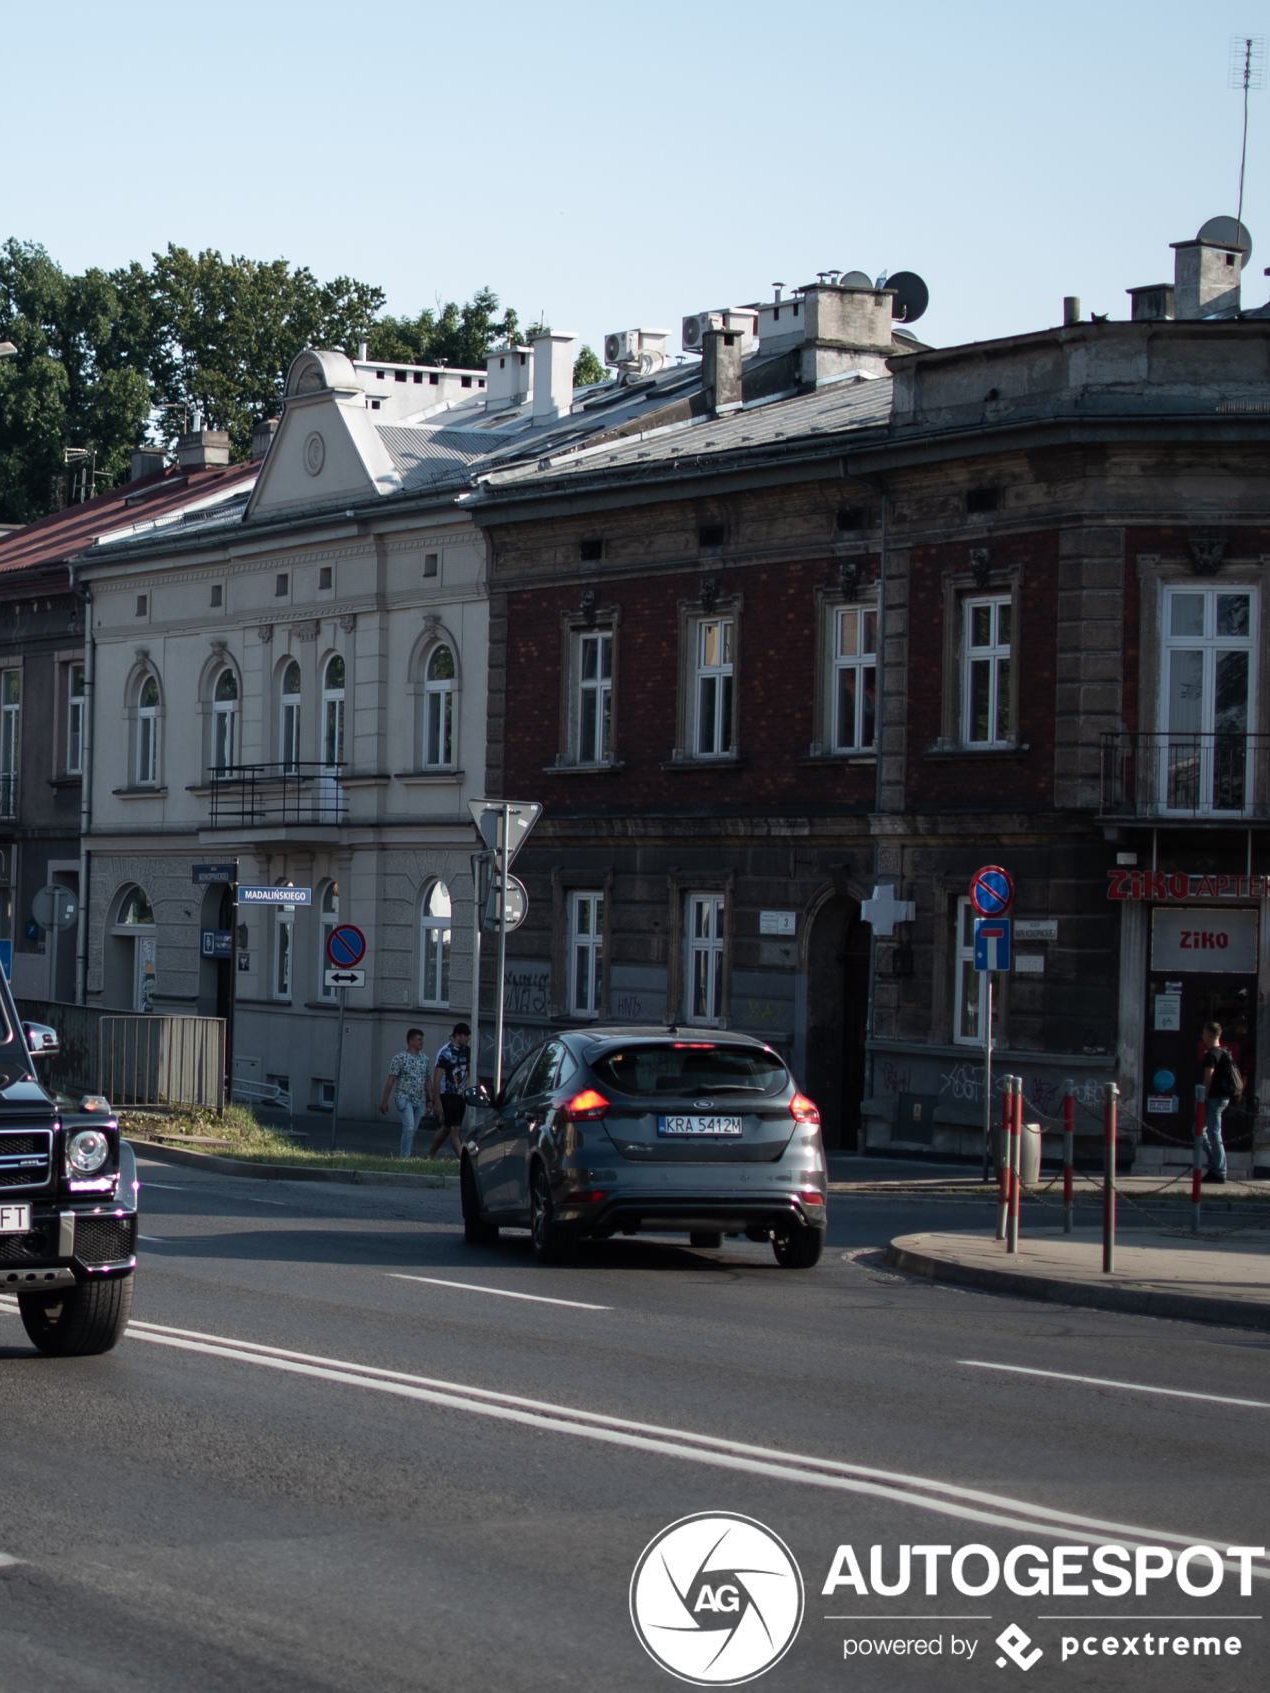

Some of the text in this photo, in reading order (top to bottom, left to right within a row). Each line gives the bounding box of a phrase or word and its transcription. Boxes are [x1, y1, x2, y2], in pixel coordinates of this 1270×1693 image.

[245, 889, 306, 901] MADALIŃSKIEGO
[666, 1118, 741, 1132] KRA 5412M
